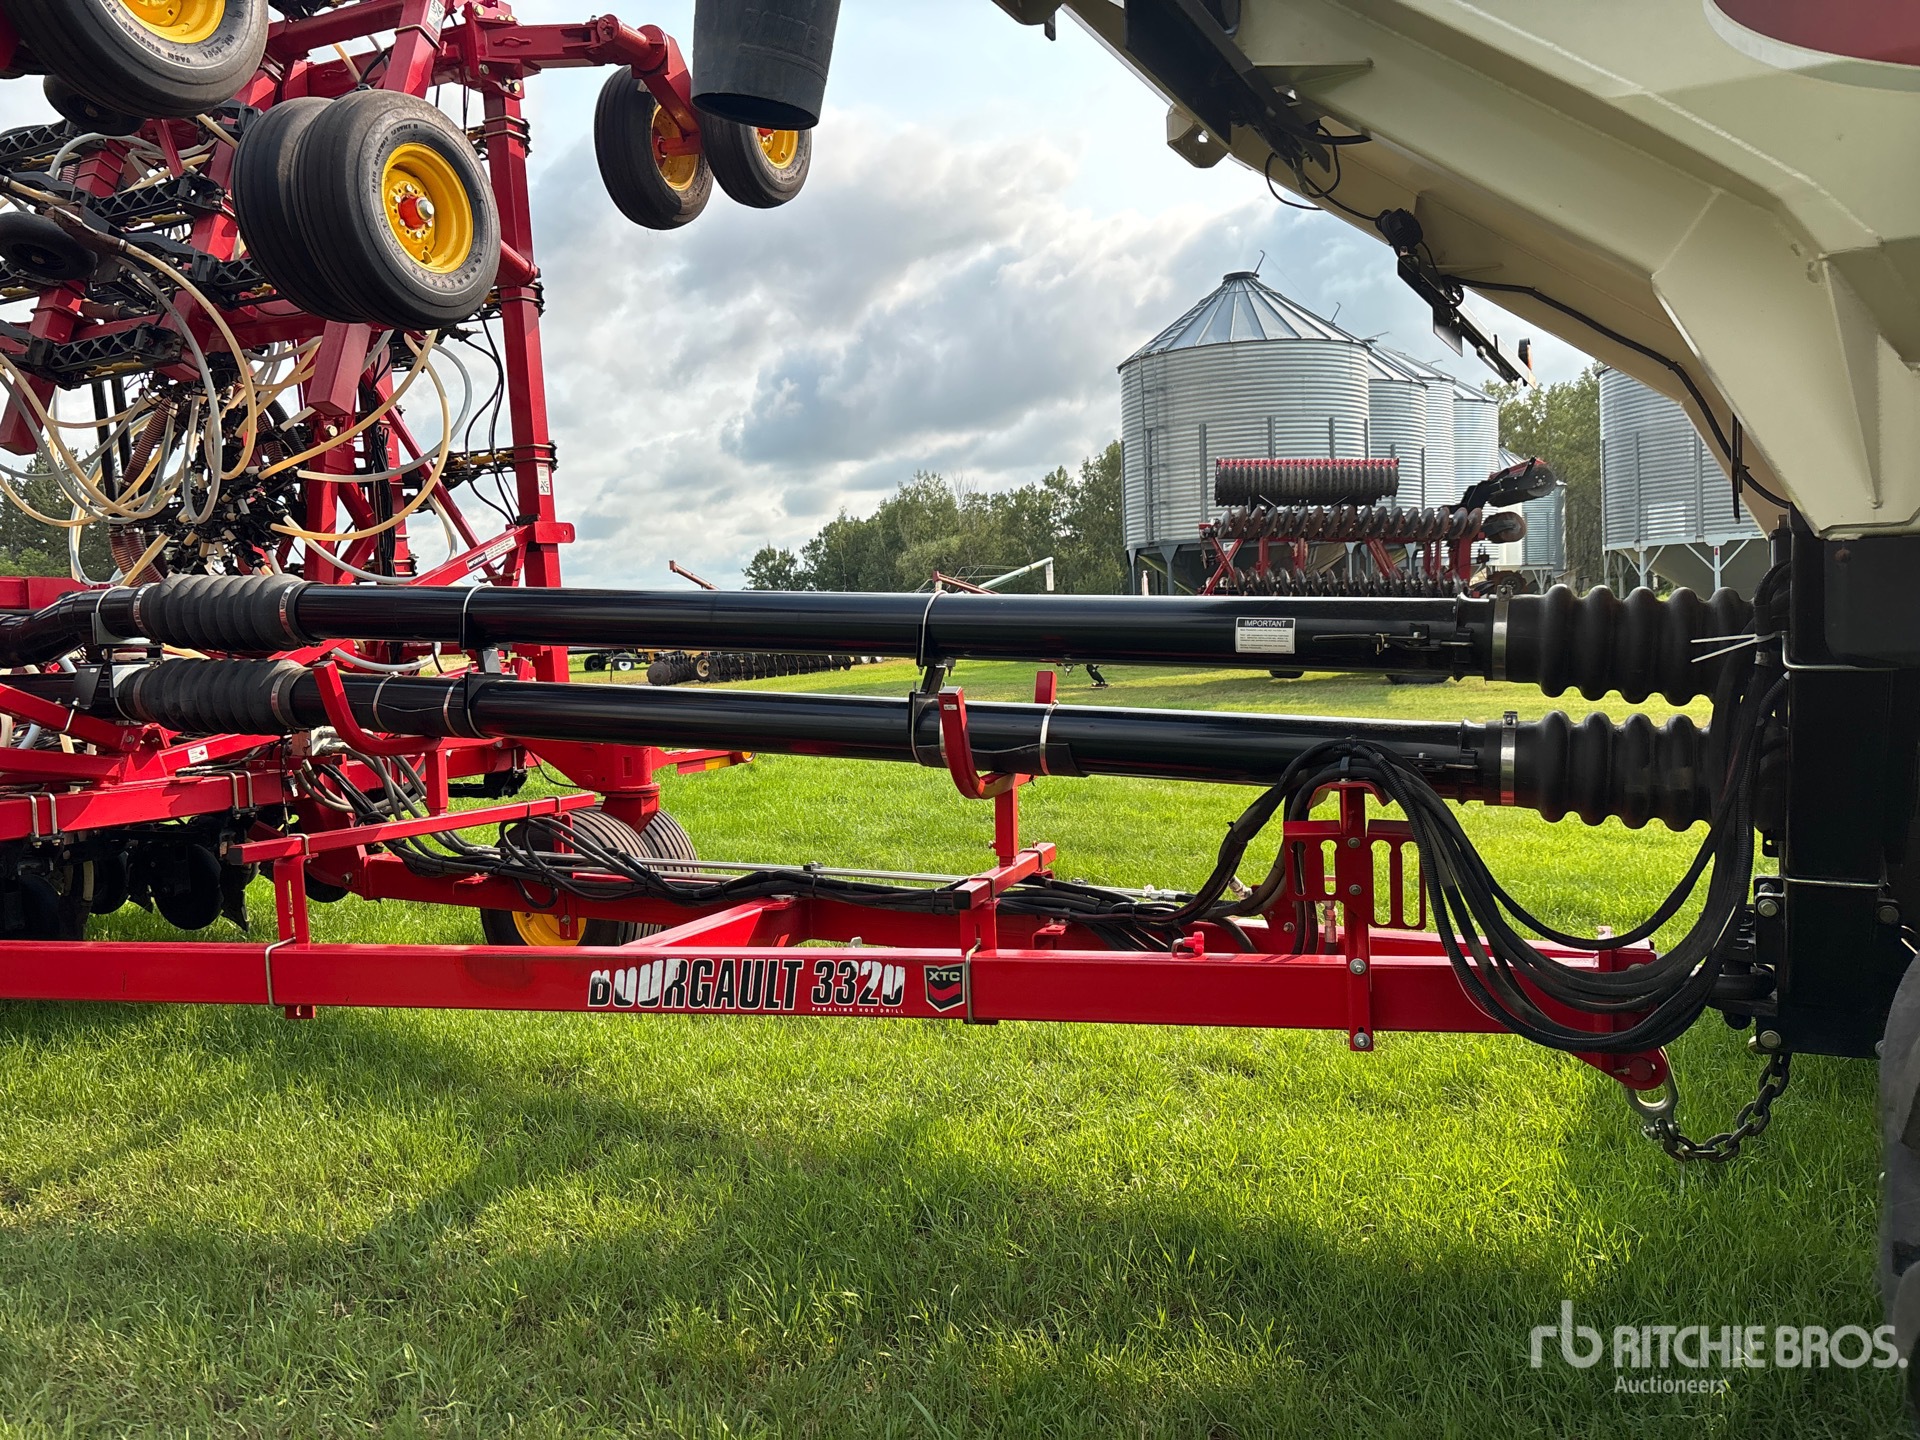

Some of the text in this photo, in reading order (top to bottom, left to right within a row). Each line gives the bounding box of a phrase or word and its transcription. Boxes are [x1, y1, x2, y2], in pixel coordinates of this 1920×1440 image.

[587, 958, 905, 1010] BOURGAULT 3320
[928, 971, 961, 982] XTC
